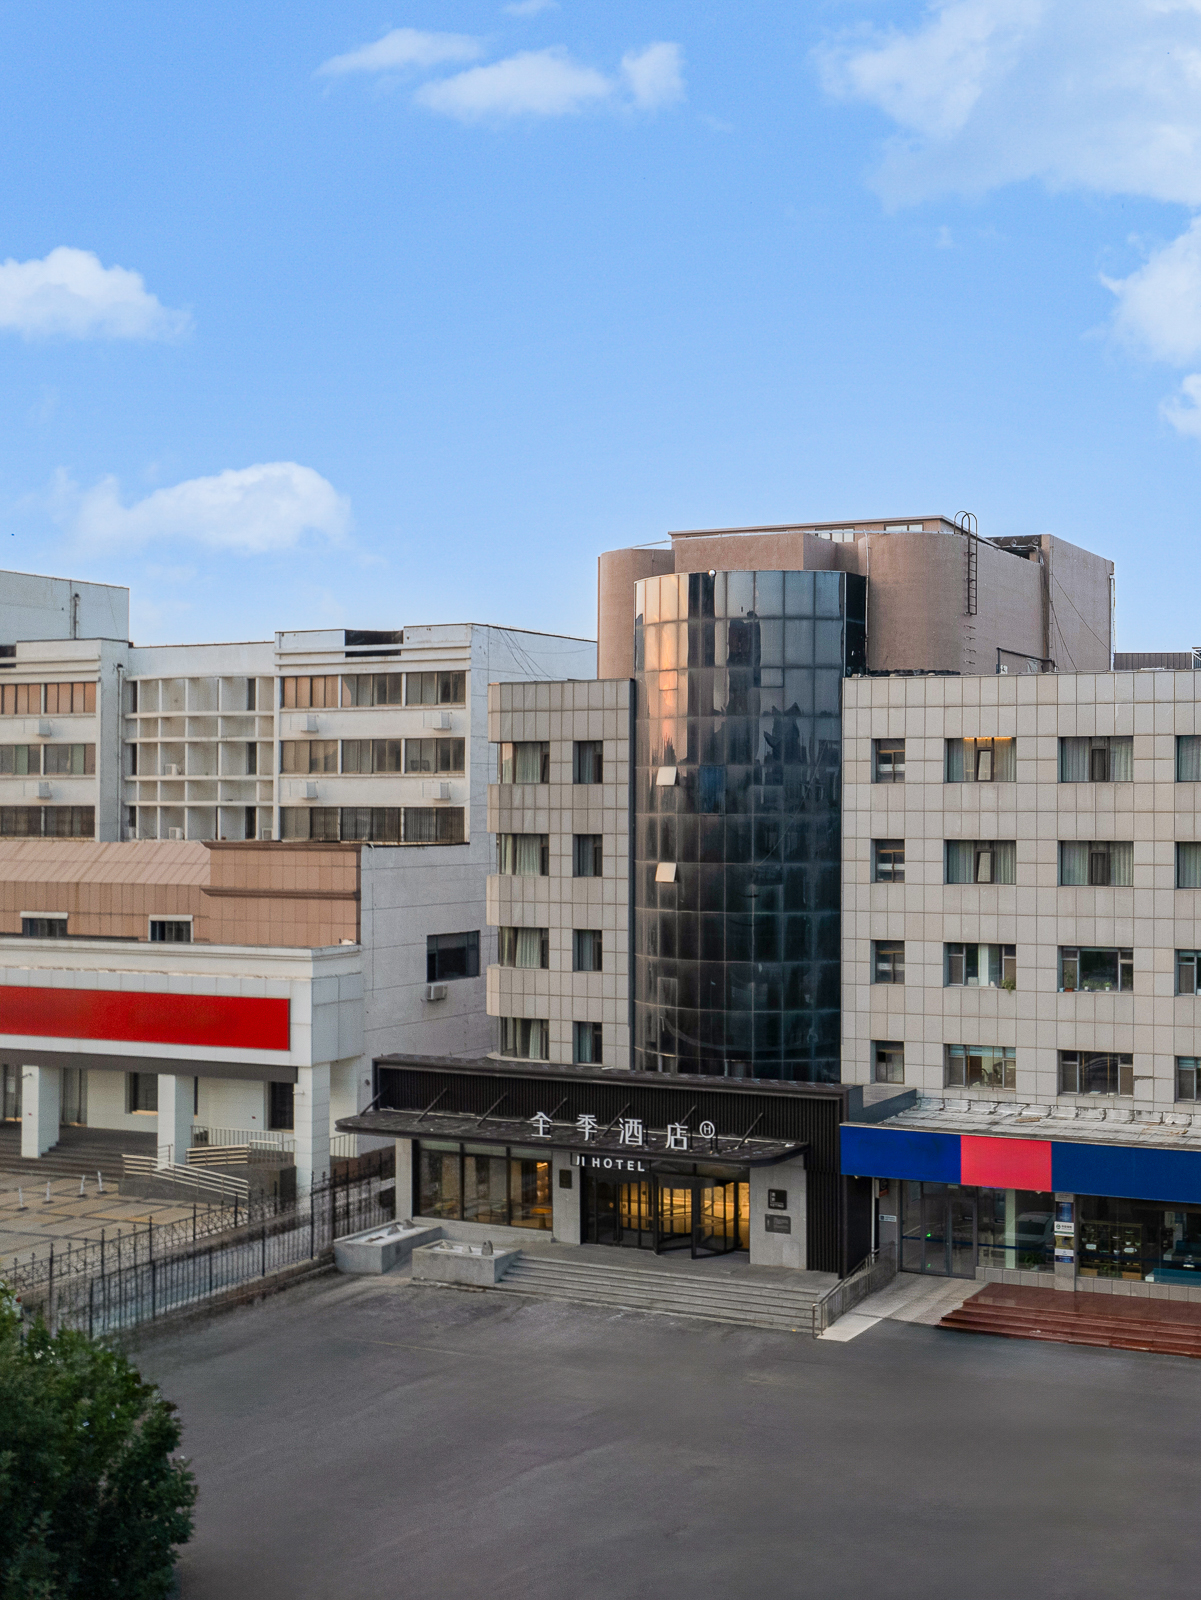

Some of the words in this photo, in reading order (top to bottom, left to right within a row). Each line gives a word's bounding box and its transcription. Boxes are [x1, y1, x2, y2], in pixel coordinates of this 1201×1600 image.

[530, 1111, 688, 1150] 全季酒店
[576, 1155, 586, 1167] JI
[592, 1157, 645, 1172] HOTEL
